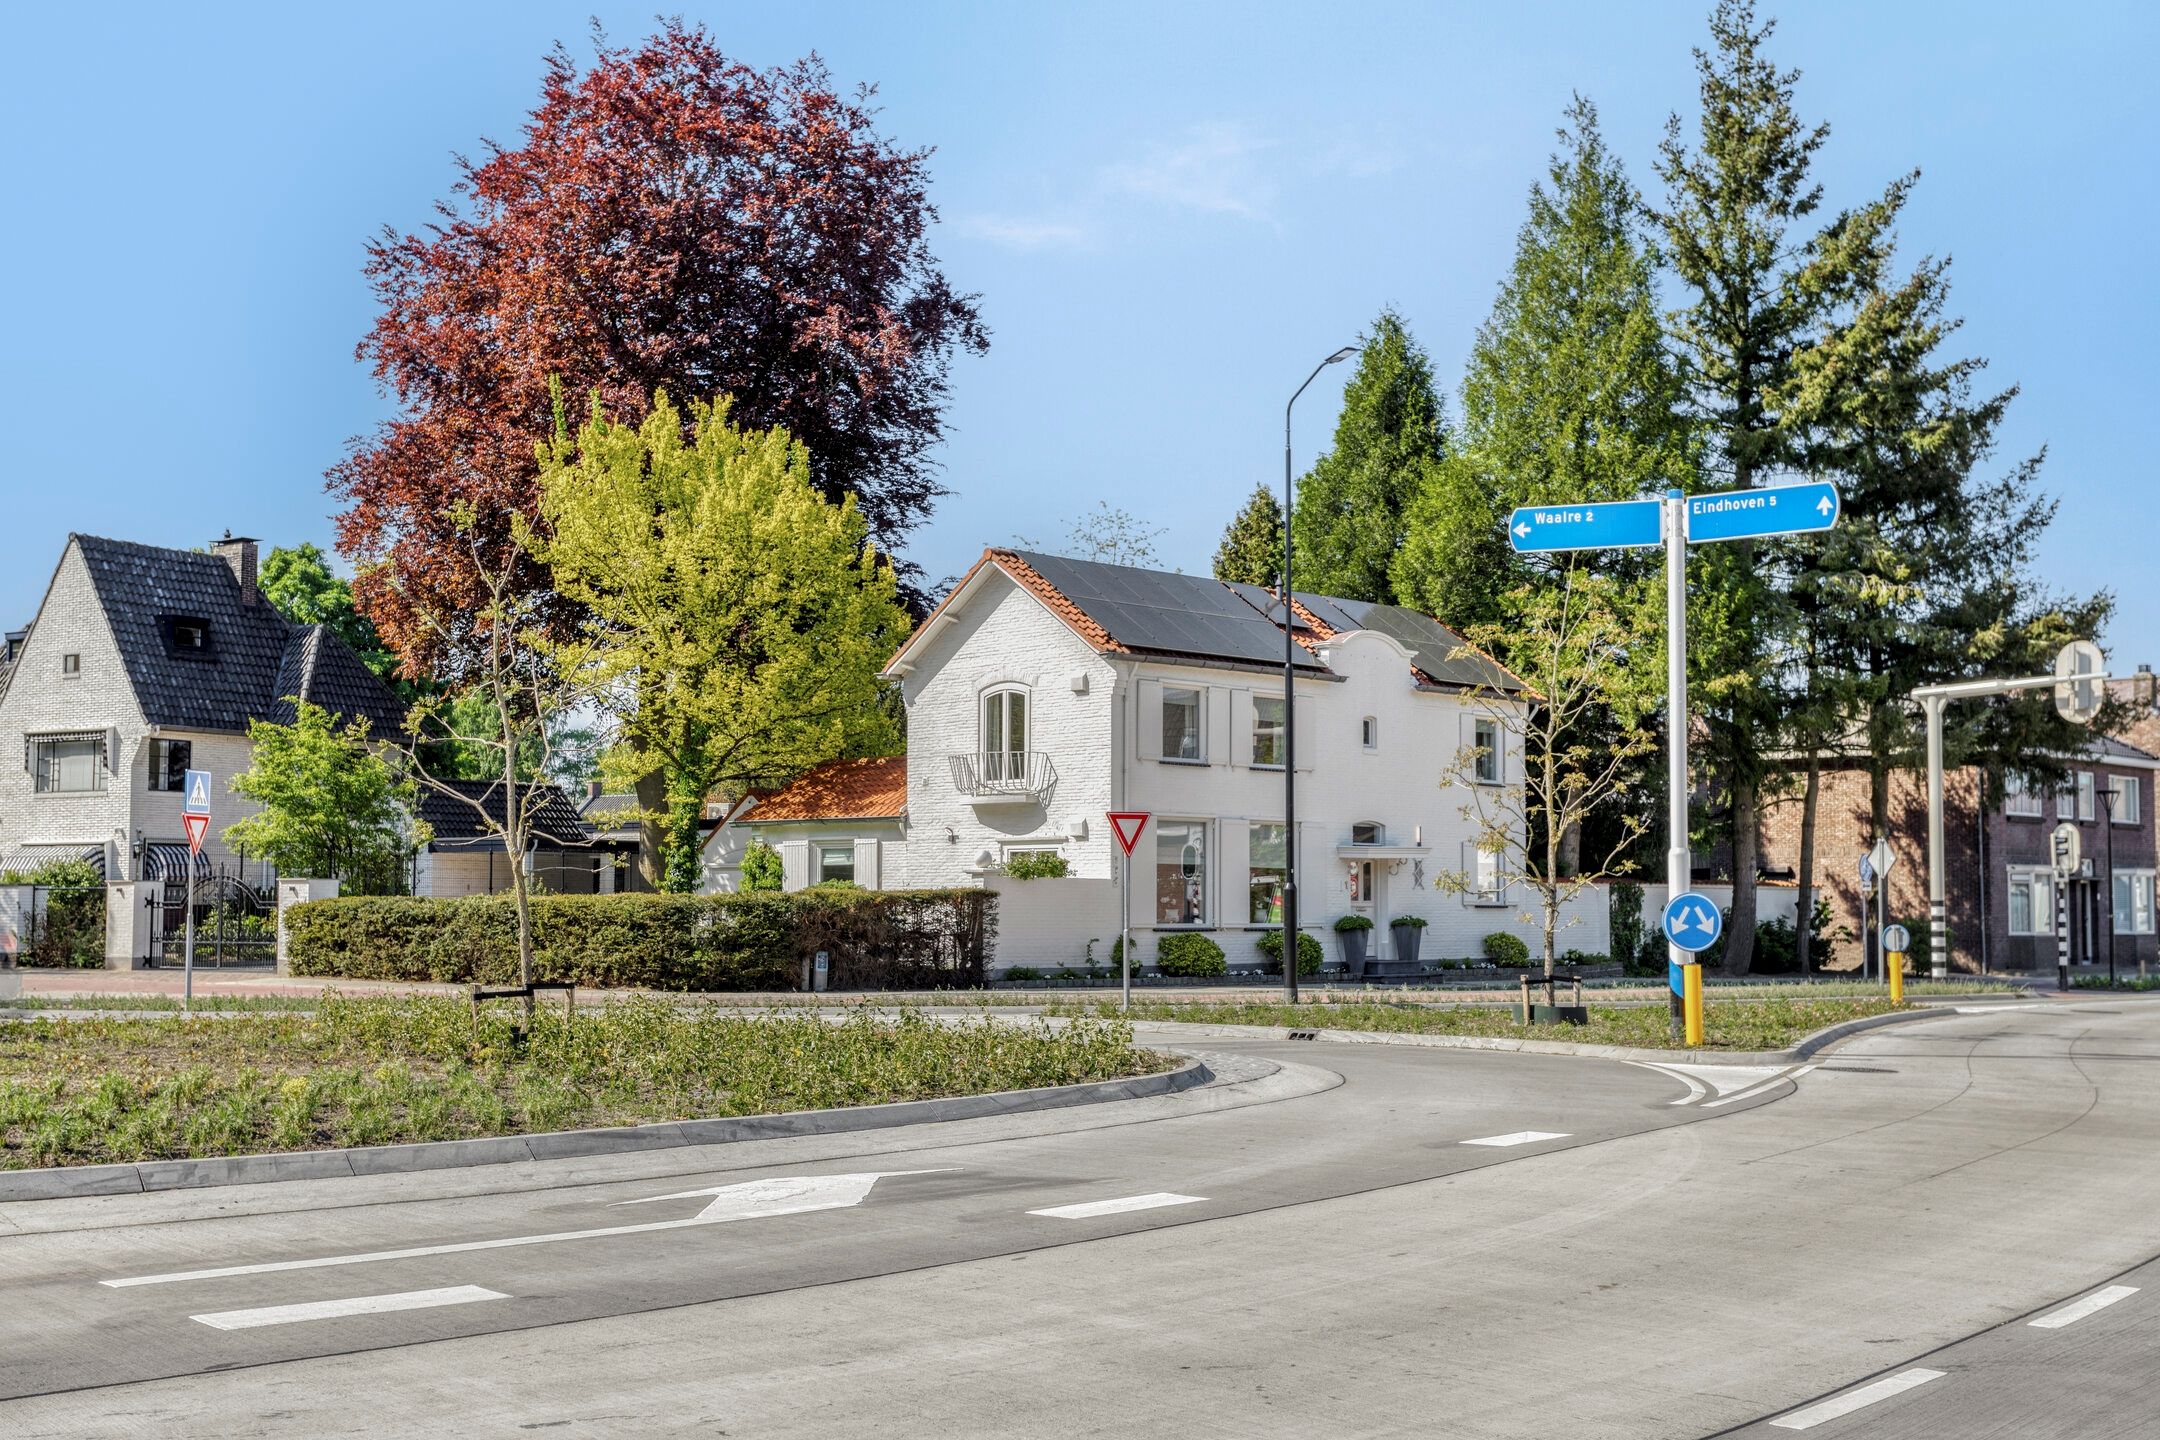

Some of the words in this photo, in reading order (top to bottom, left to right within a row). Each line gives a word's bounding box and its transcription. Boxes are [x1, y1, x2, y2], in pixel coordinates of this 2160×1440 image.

[1693, 498, 1765, 515] Eindhoven
[1769, 495, 1777, 506] 5
[1534, 511, 1582, 524] Waalre
[1585, 511, 1594, 522] 2
